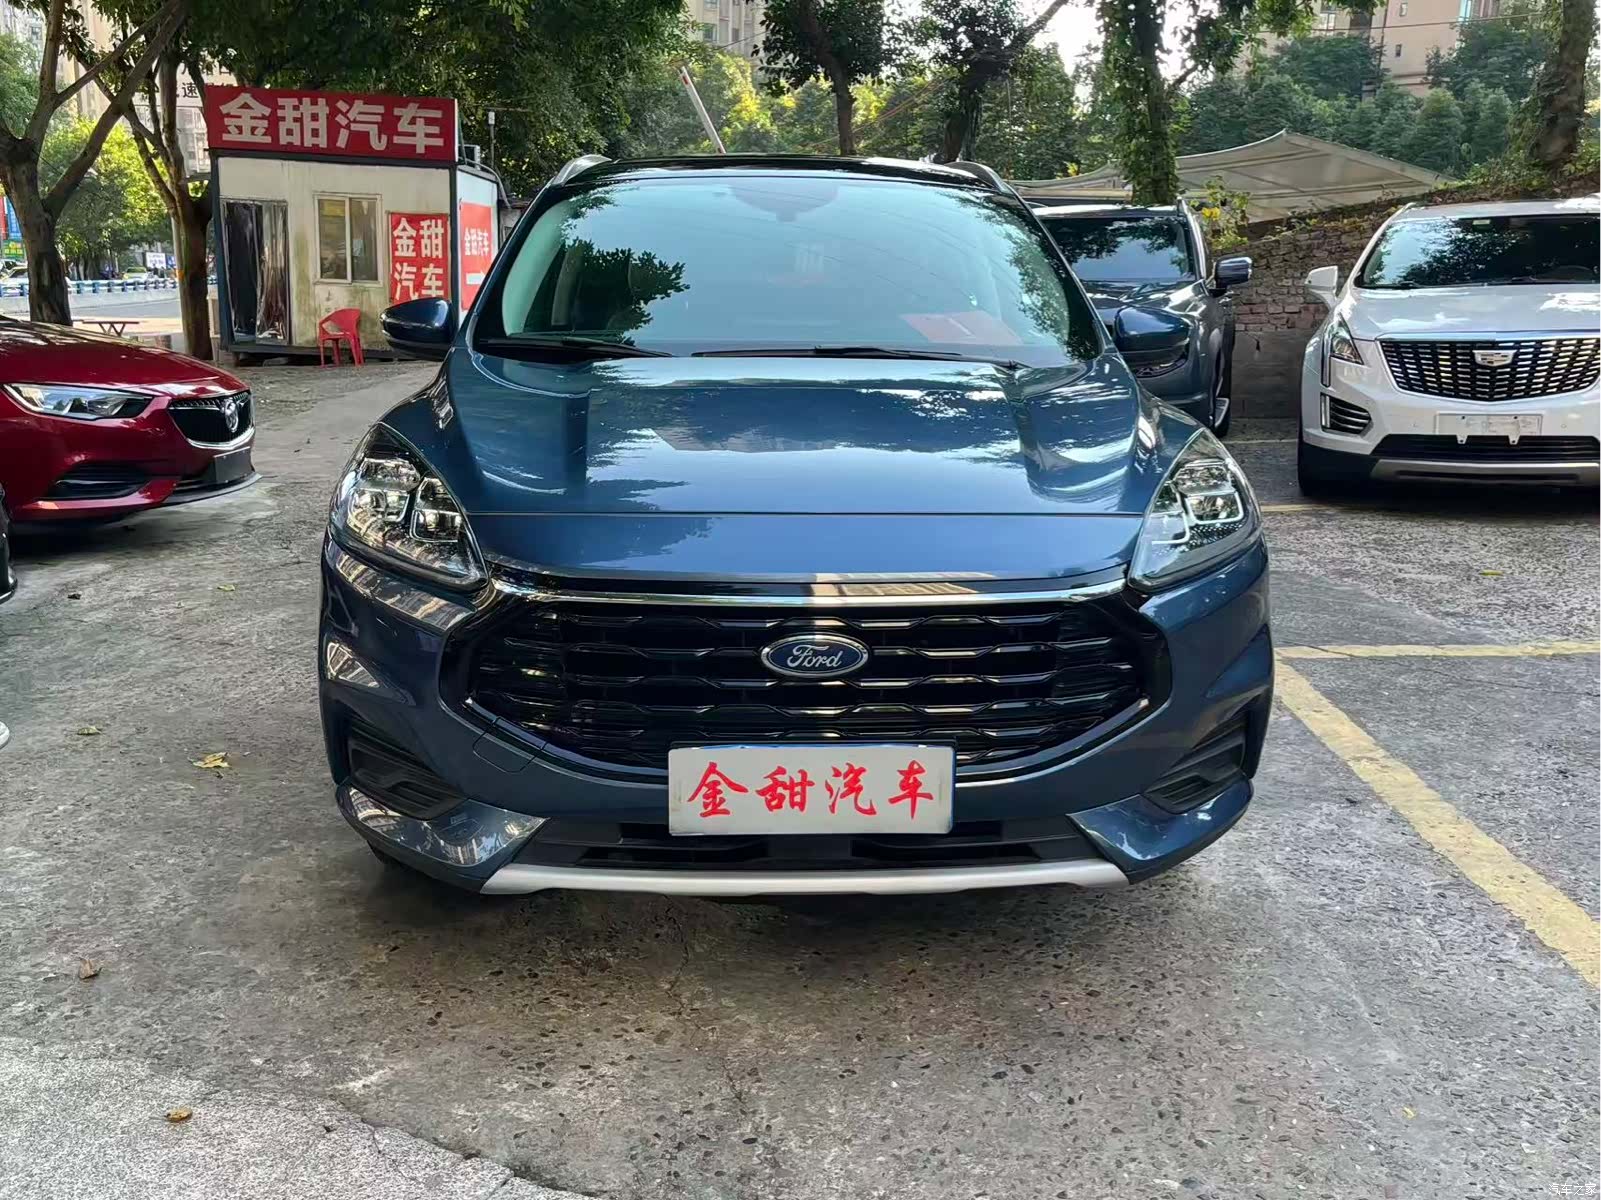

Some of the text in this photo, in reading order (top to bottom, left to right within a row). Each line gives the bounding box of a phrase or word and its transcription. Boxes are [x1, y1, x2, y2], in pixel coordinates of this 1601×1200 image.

[219, 92, 445, 154] 金甜汽车
[393, 217, 445, 258] 金甜
[393, 262, 445, 301] 汽车
[786, 644, 843, 668] Ford
[687, 760, 934, 820] 金甜汽车
